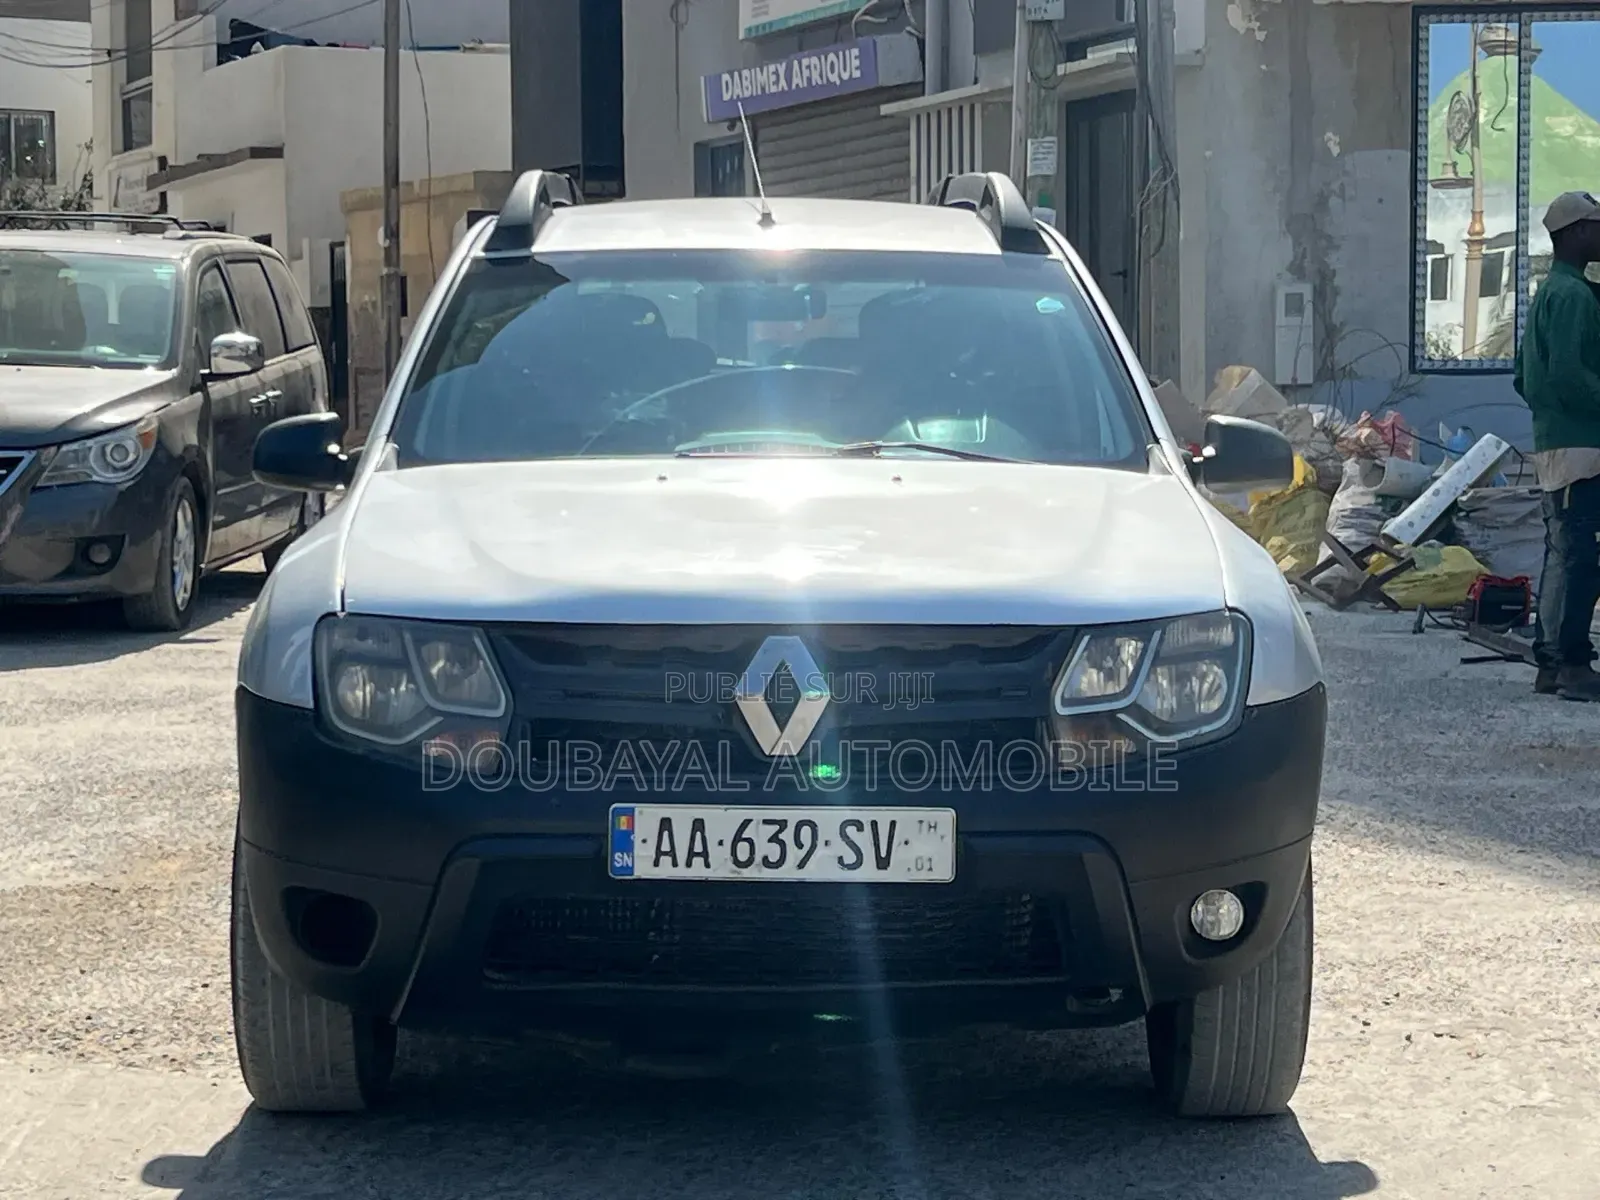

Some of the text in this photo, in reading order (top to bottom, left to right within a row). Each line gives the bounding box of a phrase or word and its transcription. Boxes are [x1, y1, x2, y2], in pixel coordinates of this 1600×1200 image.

[721, 48, 861, 101] DABIMEX AFRIQUE
[917, 819, 938, 834] TH
[614, 852, 633, 868] SN
